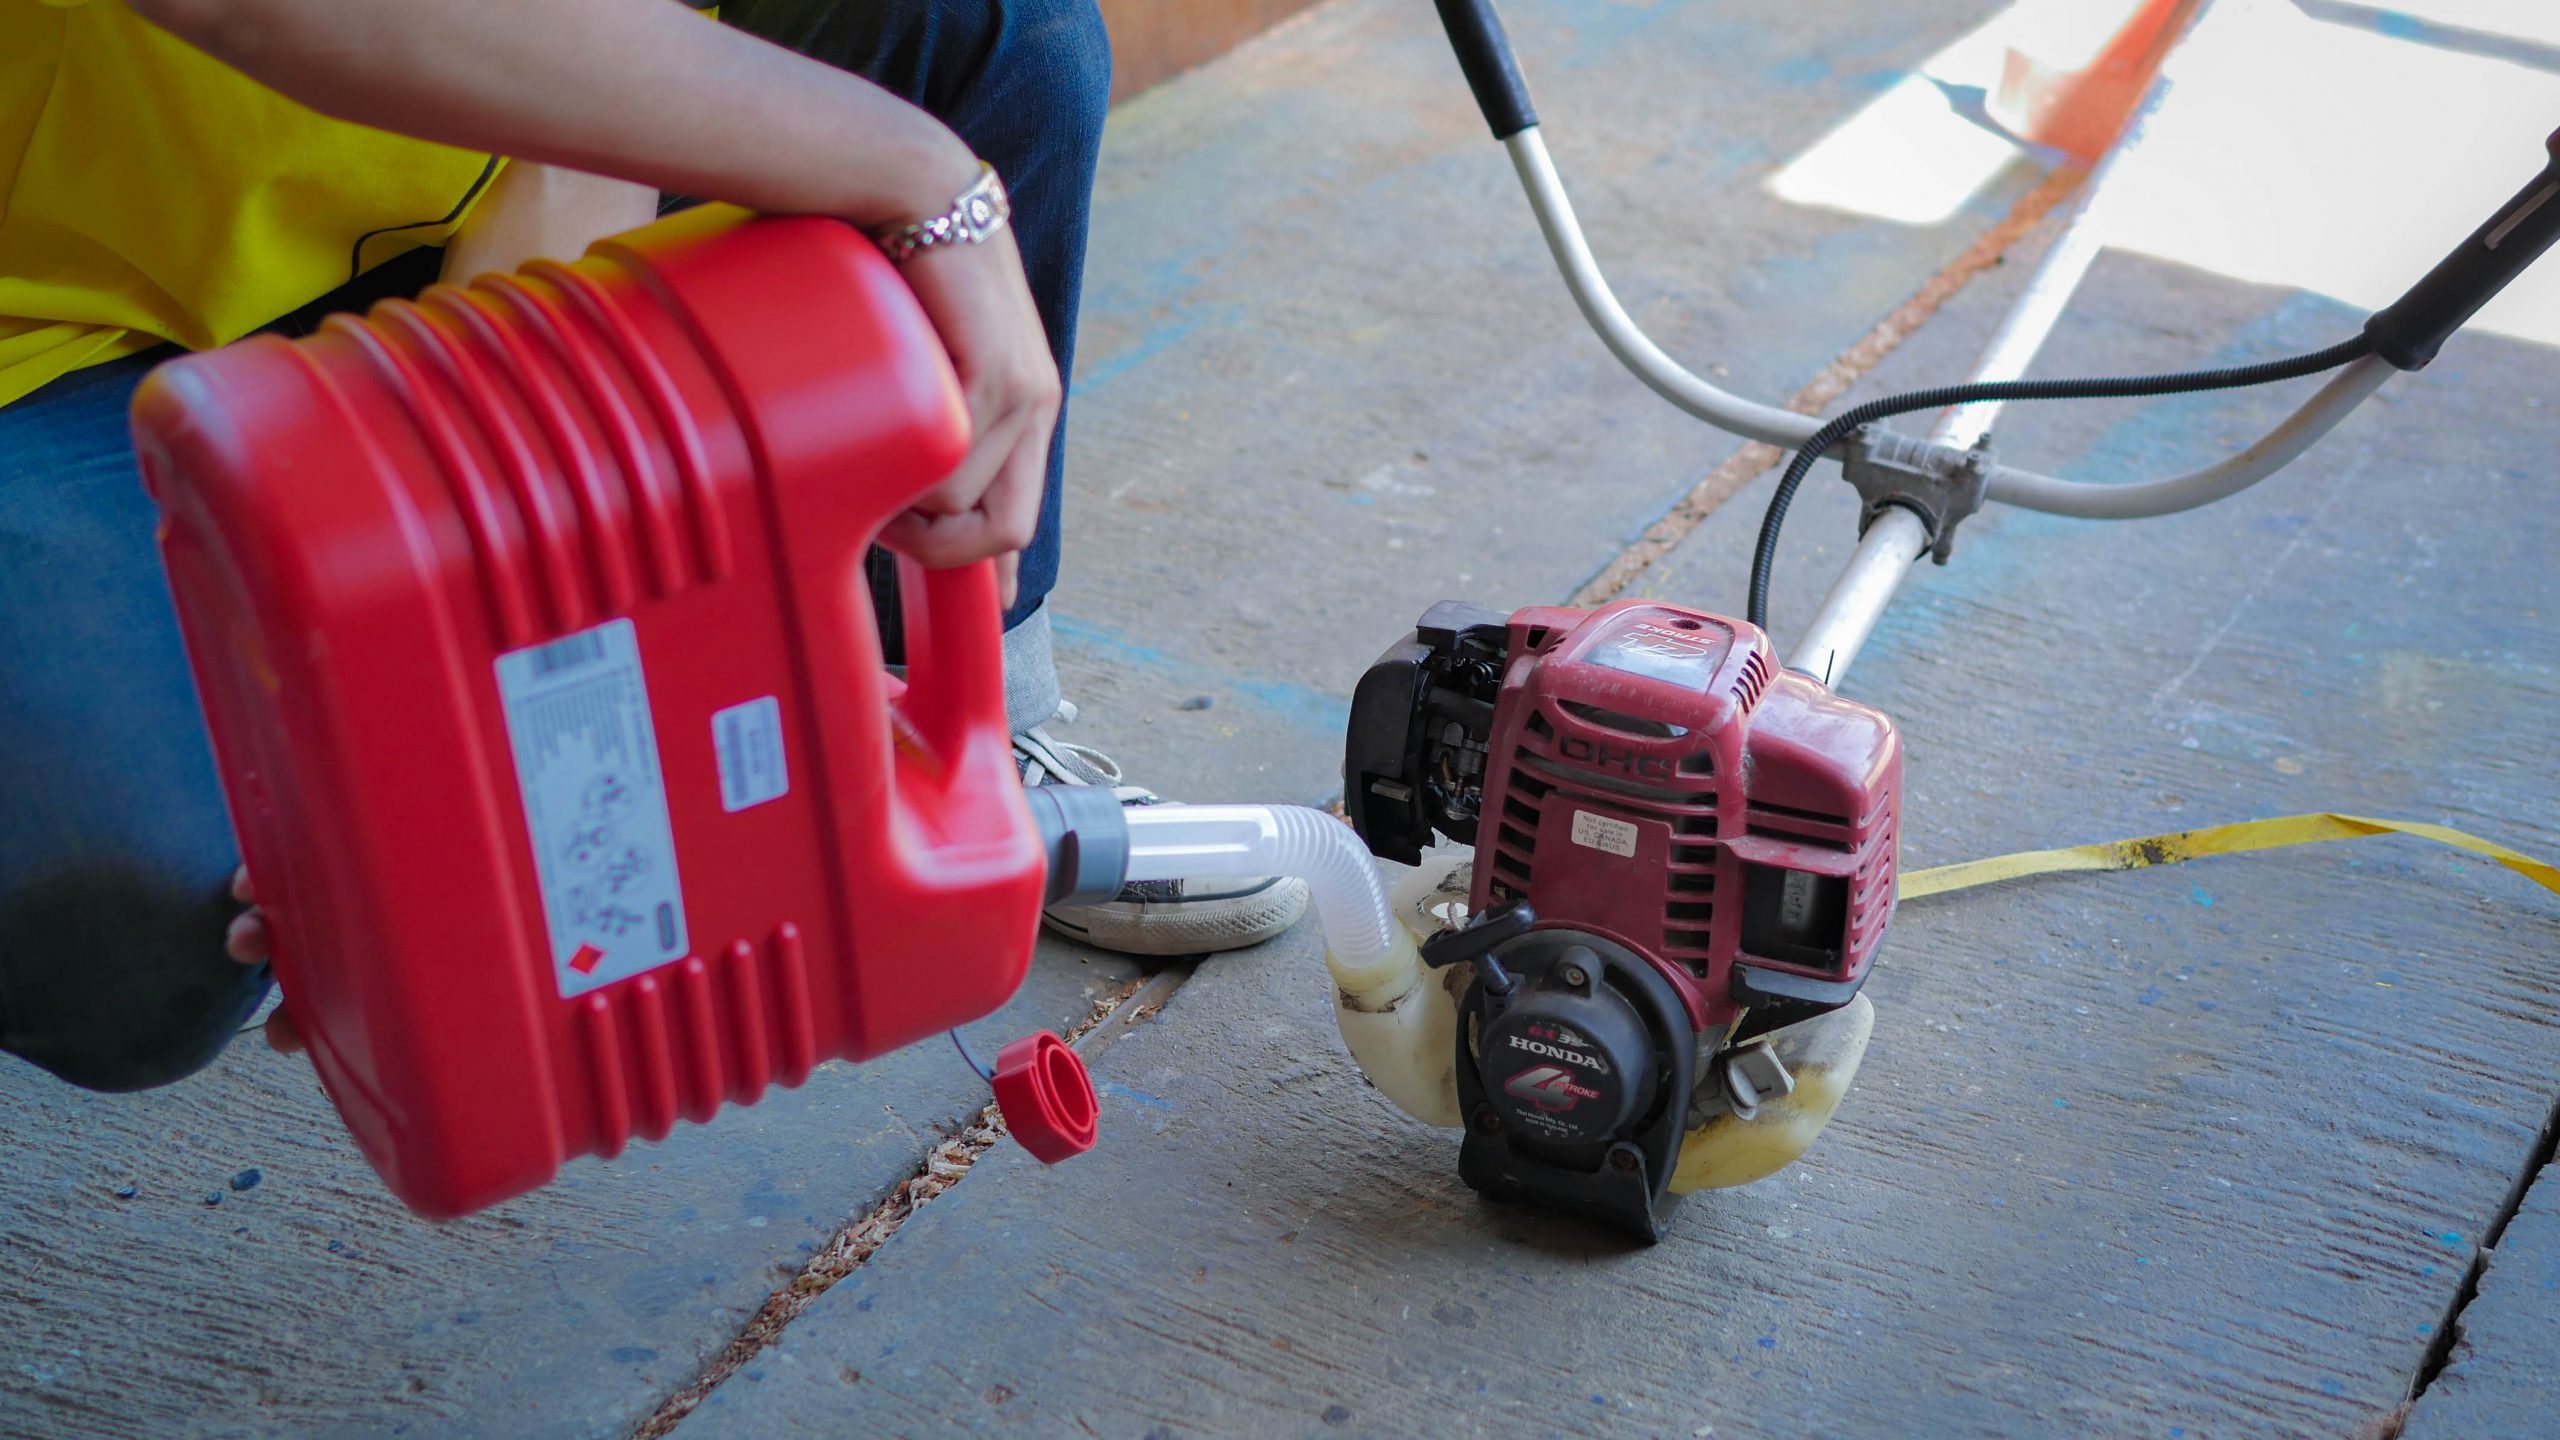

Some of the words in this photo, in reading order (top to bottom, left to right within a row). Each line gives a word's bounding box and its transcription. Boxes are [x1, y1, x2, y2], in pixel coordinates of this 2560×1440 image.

[1635, 623, 1716, 645] STROKE
[1560, 735, 1671, 781] OHC
[1583, 815, 1597, 824] Not
[1598, 820, 1629, 832] certified
[1586, 823, 1597, 831] for
[1599, 827, 1615, 835] sale
[1509, 1035, 1601, 1070] HONDA
[1505, 1064, 1577, 1111] 4
